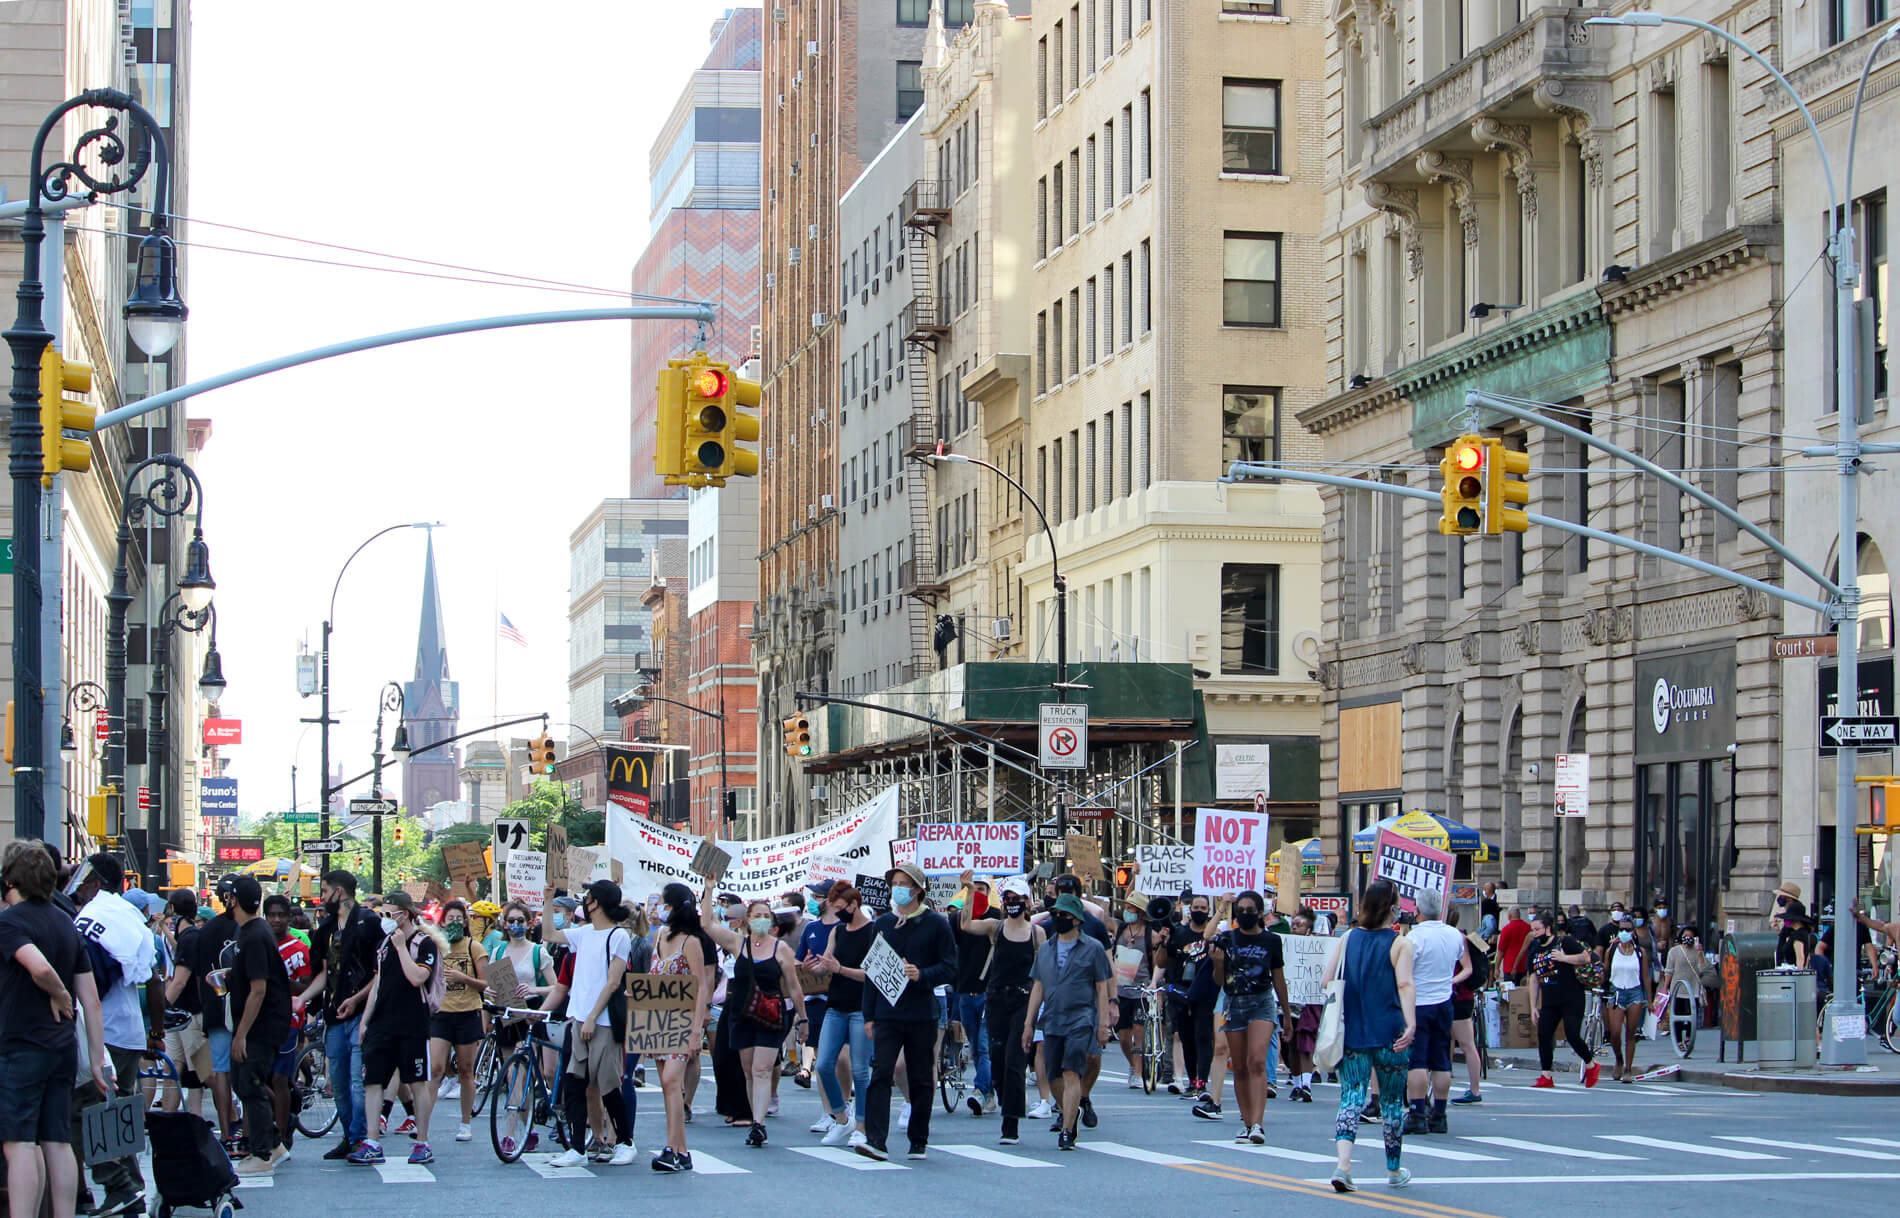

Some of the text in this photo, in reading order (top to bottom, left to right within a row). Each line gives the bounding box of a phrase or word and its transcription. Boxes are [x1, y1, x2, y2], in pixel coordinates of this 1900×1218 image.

[6, 543, 14, 560] S
[1776, 640, 1816, 656] Court St
[1050, 707, 1077, 716] TRUCK
[1675, 709, 1708, 722] CARE
[1043, 717, 1084, 725] RESTRICTION
[1837, 726, 1888, 738] ONE WAY
[201, 786, 237, 796] Bruno's
[202, 801, 237, 809] Home Center
[1070, 809, 1102, 817] Joralemon
[918, 824, 1019, 841] REPARATIONS
[1042, 828, 1057, 836] ONE
[1205, 815, 1259, 845] NOT
[639, 830, 664, 847] THE
[667, 843, 693, 858] POL
[767, 852, 785, 864] BE
[762, 843, 777, 853] OF
[780, 831, 817, 848] RACIST
[956, 842, 982, 855] FOR
[923, 856, 965, 869] BLACK
[973, 855, 1019, 868] PEOPLE
[1141, 845, 1194, 863] BLACK
[1384, 846, 1446, 874] DISMANTLE
[639, 859, 704, 885] THROUGH
[716, 878, 780, 893] OCIALIST
[740, 856, 809, 880] LIBERATIO
[1150, 861, 1186, 874] LIVES
[1383, 859, 1444, 893] WHITE
[1141, 876, 1192, 891] MATTER
[1203, 865, 1257, 890] KAREN
[1295, 937, 1325, 953] BLACK
[425, 953, 435, 965] 3
[874, 950, 898, 996] POLICE
[885, 963, 906, 998] STATE
[631, 978, 694, 1001] BLACK
[631, 1008, 692, 1033] LIVES
[628, 1027, 693, 1051] MATTER
[415, 1064, 424, 1077] 3
[88, 1103, 136, 1157] BLM
